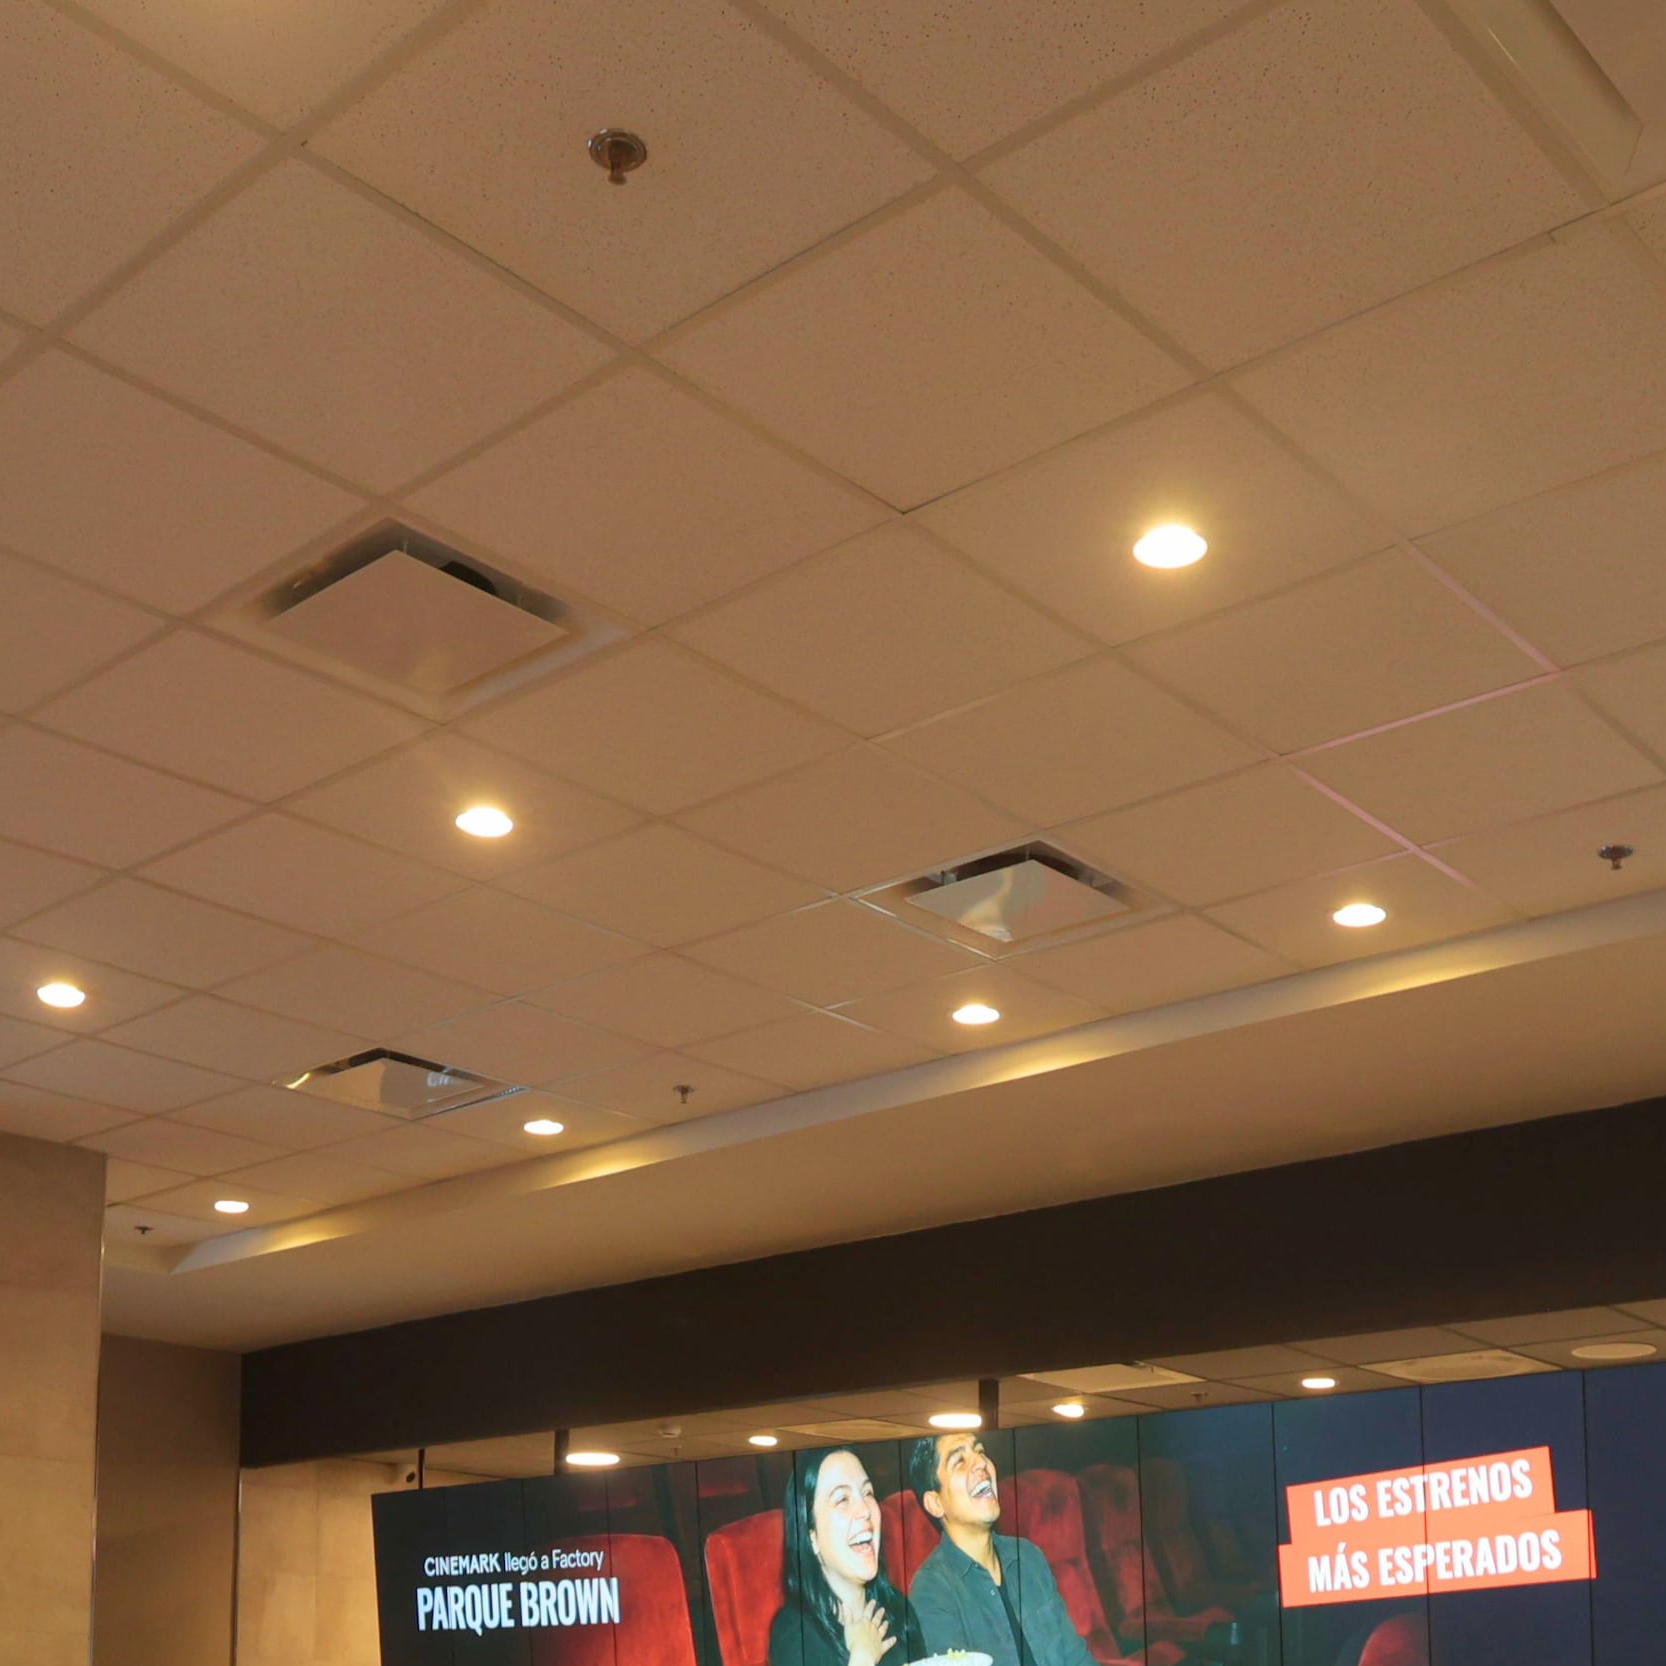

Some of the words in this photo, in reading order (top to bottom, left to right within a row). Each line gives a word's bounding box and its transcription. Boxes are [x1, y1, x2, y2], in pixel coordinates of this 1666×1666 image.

[1314, 1484, 1369, 1527] LOS
[1376, 1459, 1533, 1518] ESTRENOS
[424, 1553, 502, 1576] CINEMARK
[504, 1551, 538, 1576] llegó
[541, 1556, 549, 1570] a
[552, 1549, 604, 1571] Factory
[1308, 1541, 1370, 1593] MÁS
[1377, 1529, 1563, 1586] ESPERADOS
[416, 1582, 515, 1636] PARQUE
[520, 1577, 620, 1628] BROWN
